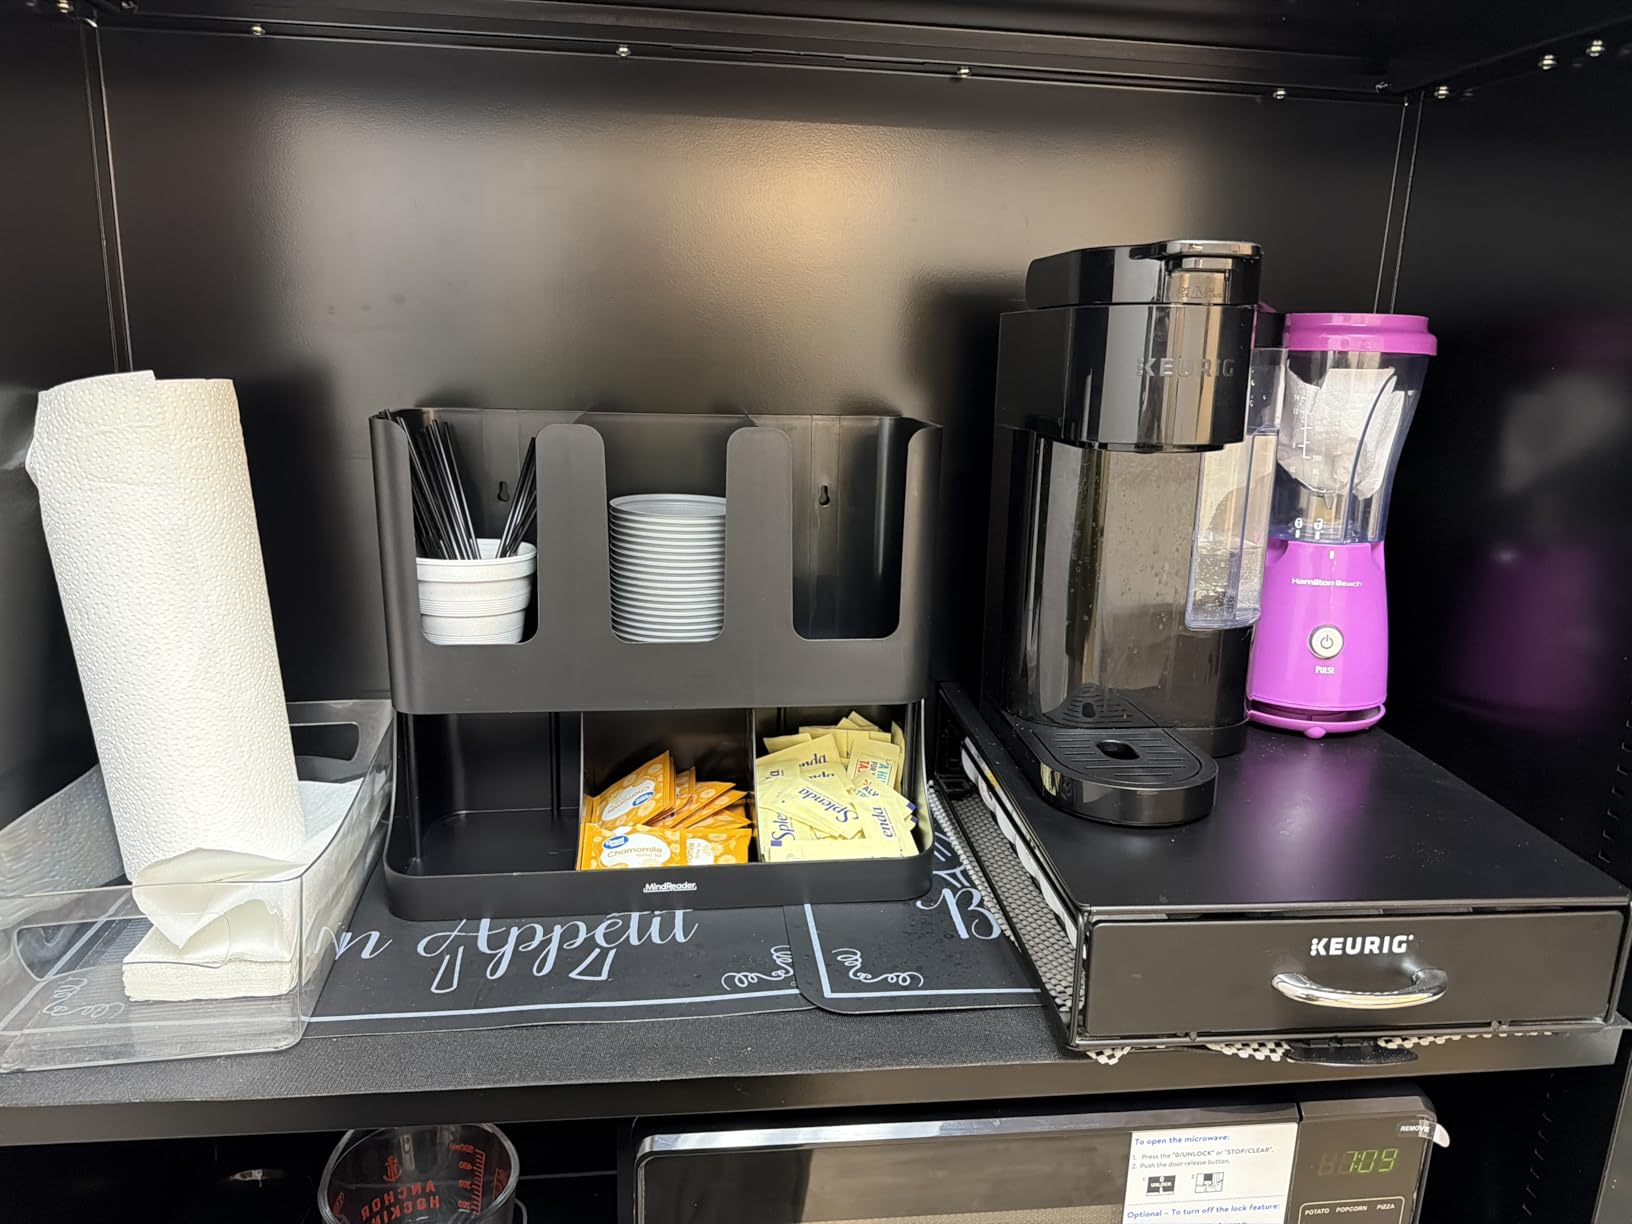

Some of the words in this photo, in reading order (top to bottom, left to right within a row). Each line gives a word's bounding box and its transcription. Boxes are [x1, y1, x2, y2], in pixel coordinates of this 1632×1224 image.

[1136, 357, 1236, 378] KEURIG
[1291, 577, 1335, 587] Hamilton
[1335, 577, 1362, 587] Beach
[1315, 666, 1336, 674] PULSE
[797, 788, 859, 823] Splenda
[772, 812, 796, 841] Sple
[872, 807, 894, 839] enda
[607, 847, 663, 858] Chamomile
[644, 881, 697, 893] MindReader
[1310, 935, 1413, 956] KEURIG
[1400, 1125, 1430, 1133] REMOVE
[1135, 1138, 1145, 1146] To
[1147, 1138, 1167, 1148] open
[1169, 1136, 1182, 1144] the
[1184, 1135, 1230, 1143] microwave:
[1141, 1153, 1159, 1161] Press
[1160, 1152, 1171, 1160] the
[1347, 1148, 1399, 1173] 7:09
[1140, 1161, 1156, 1169] Push
[1168, 1160, 1183, 1168] door
[1184, 1159, 1207, 1167] release
[1127, 1210, 1163, 1220] Optional
[1172, 1208, 1181, 1216] To
[1202, 1206, 1215, 1214] off
[1216, 1205, 1229, 1213] the
[1230, 1204, 1247, 1212] lock
[1249, 1203, 1281, 1211] feature:
[1305, 1208, 1330, 1216] POTATO
[1336, 1205, 1368, 1213] POPCORN
